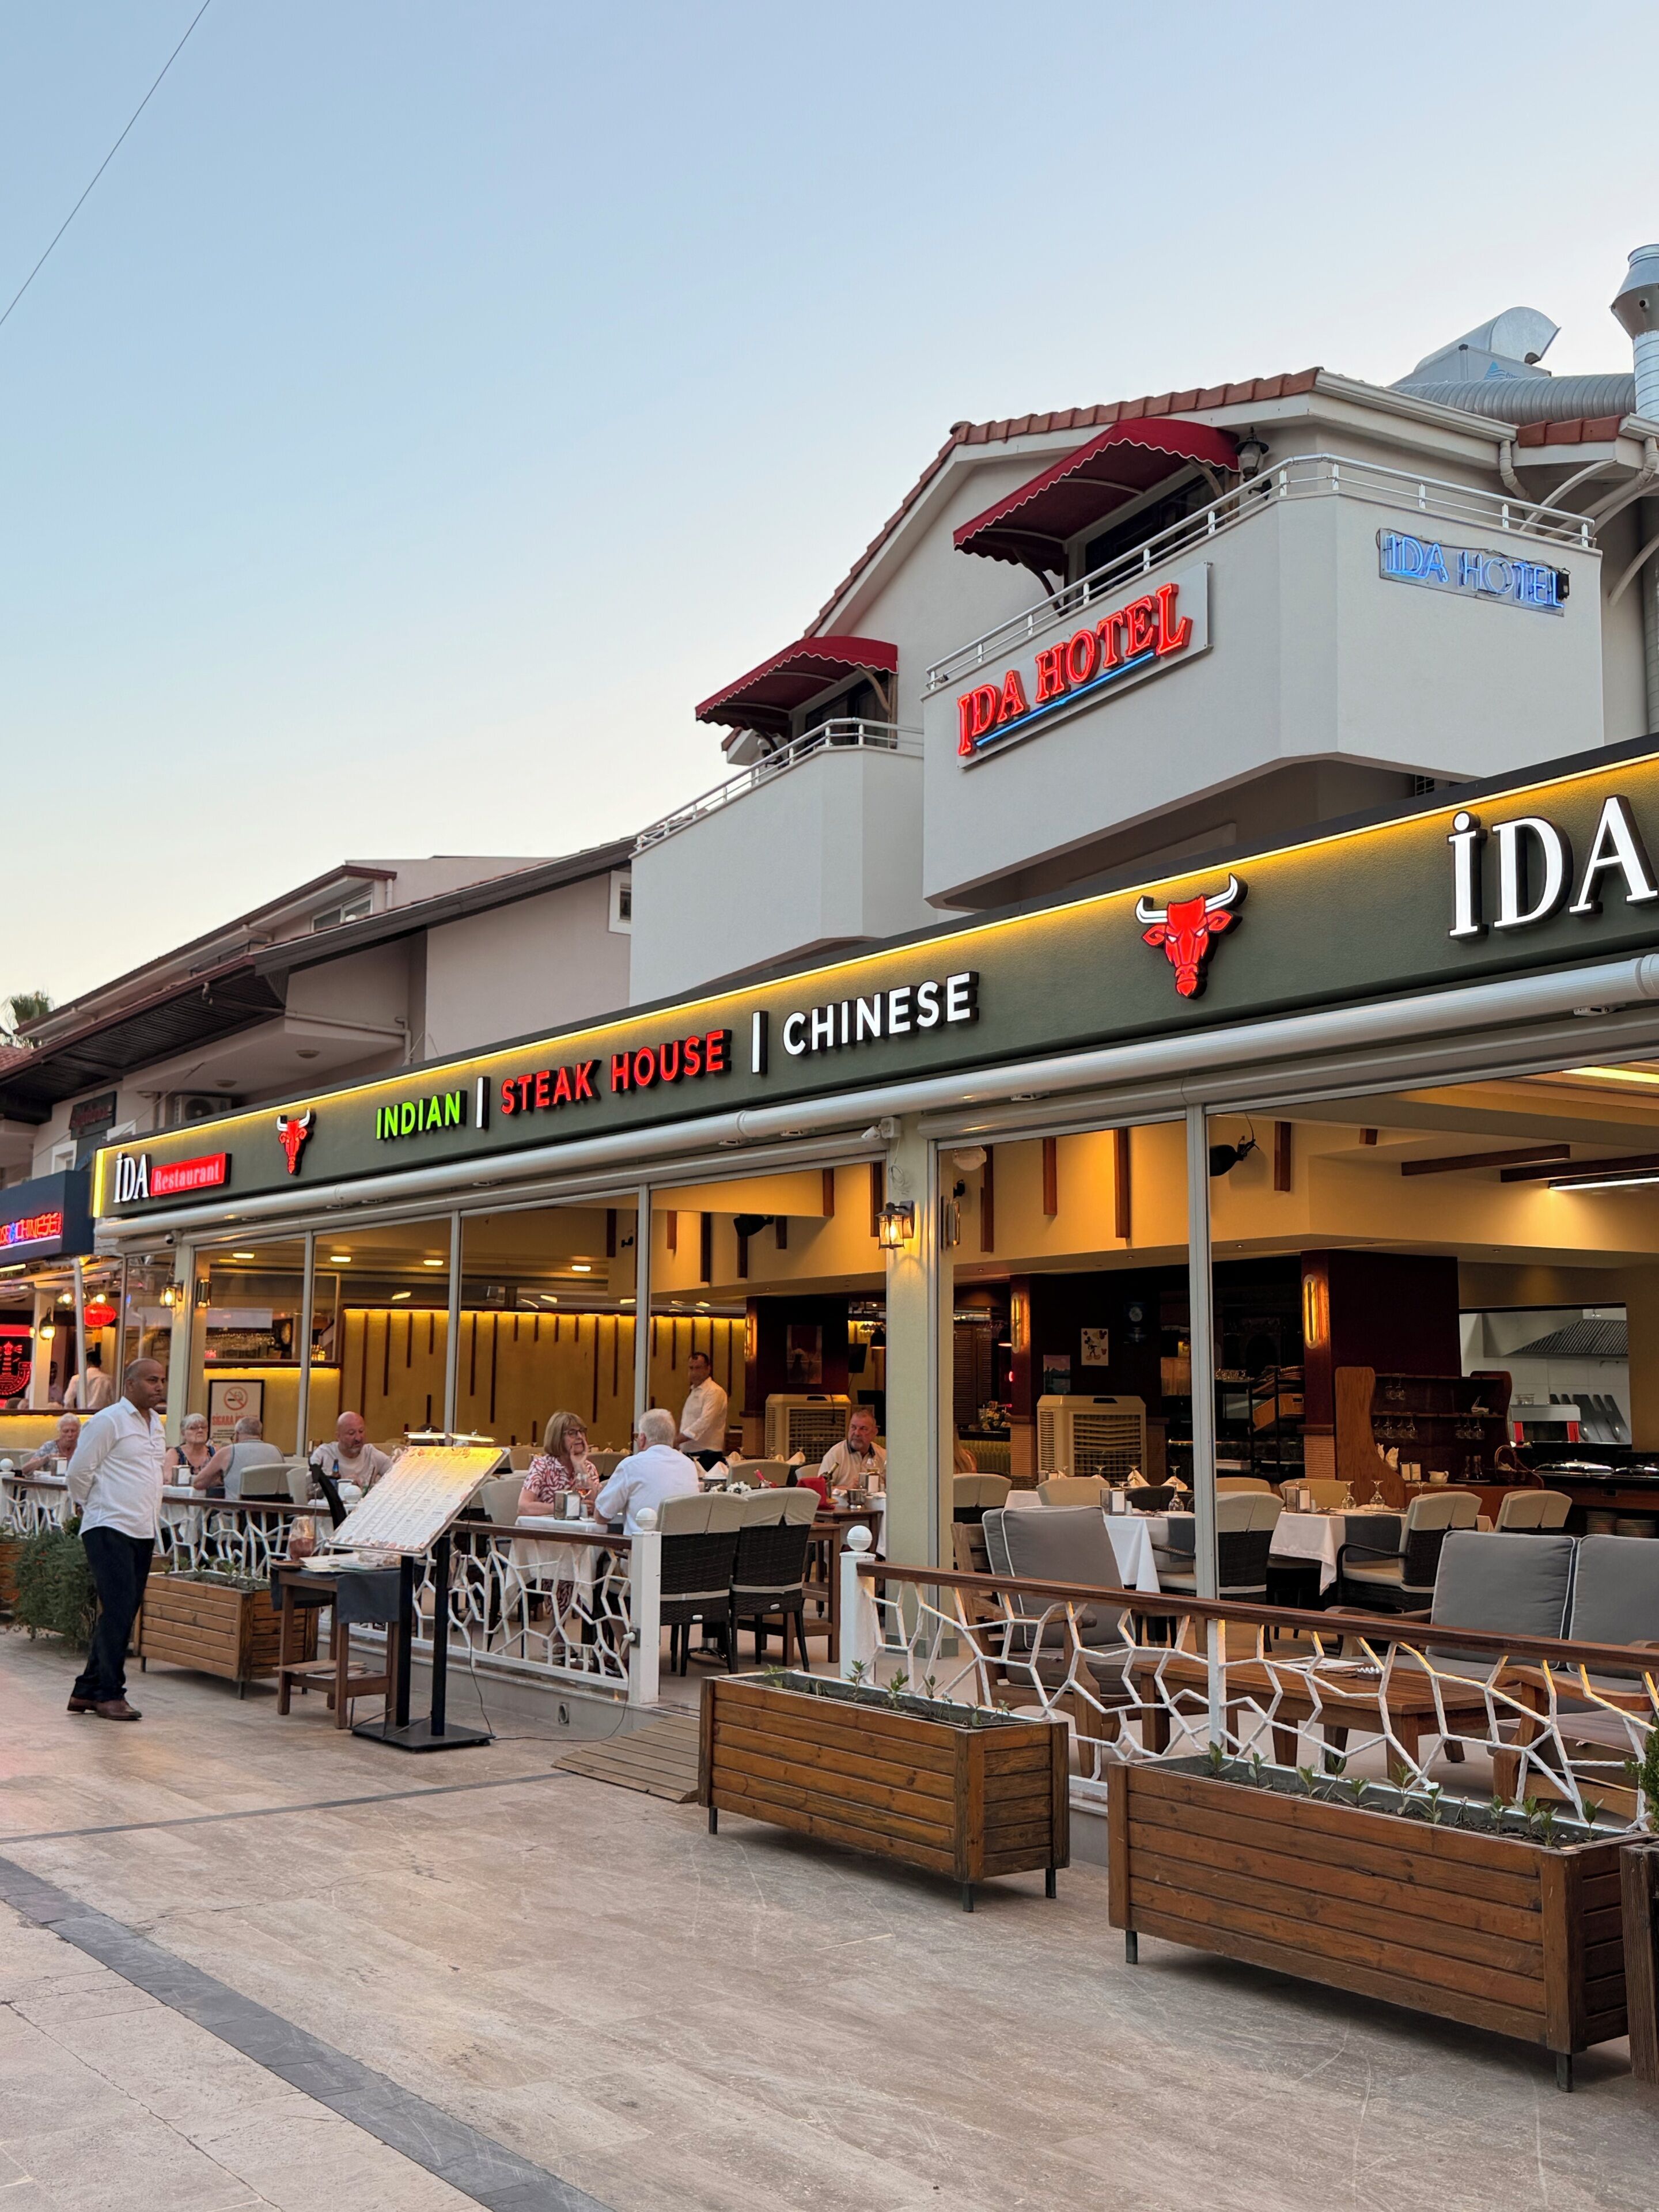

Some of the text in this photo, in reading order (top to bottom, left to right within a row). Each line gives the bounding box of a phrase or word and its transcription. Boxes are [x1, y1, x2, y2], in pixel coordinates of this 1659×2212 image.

[1385, 534, 1565, 608] IDA HOTEL
[957, 582, 1193, 756] IDA HOTEL
[1447, 794, 1659, 939] İDA
[376, 972, 978, 1141] INDIAN STEAK HOUSE CHINESE
[15, 1212, 62, 1240] CHINESE
[113, 1150, 221, 1203] İDA Restaurant
